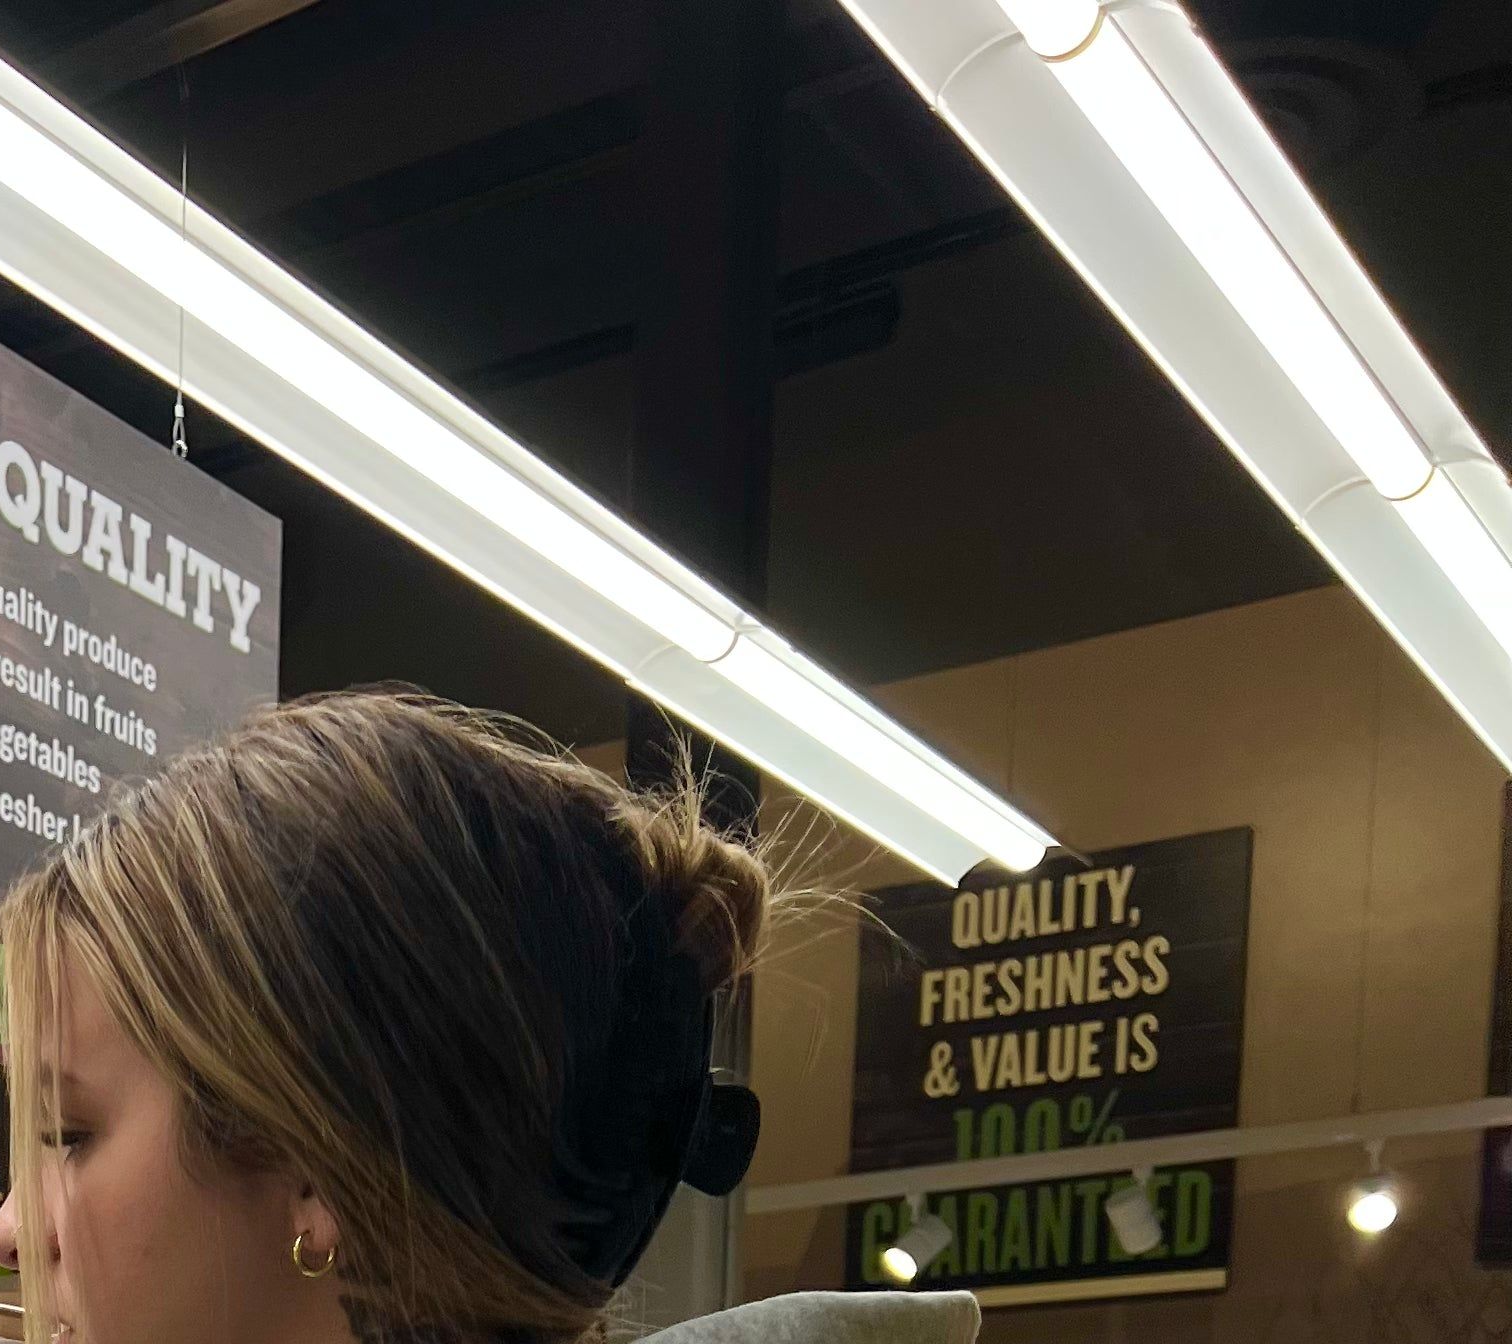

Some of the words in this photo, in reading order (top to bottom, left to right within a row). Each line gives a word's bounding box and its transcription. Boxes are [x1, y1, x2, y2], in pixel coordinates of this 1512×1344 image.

[63, 621, 157, 692] produce
[66, 680, 89, 724] in
[94, 695, 157, 756] fruits
[952, 865, 1141, 949] QUALITY,
[920, 936, 1170, 1026] FRESHNESS
[924, 1041, 960, 1098] &
[970, 1021, 1103, 1091] VALUE
[1115, 1012, 1159, 1074] IS
